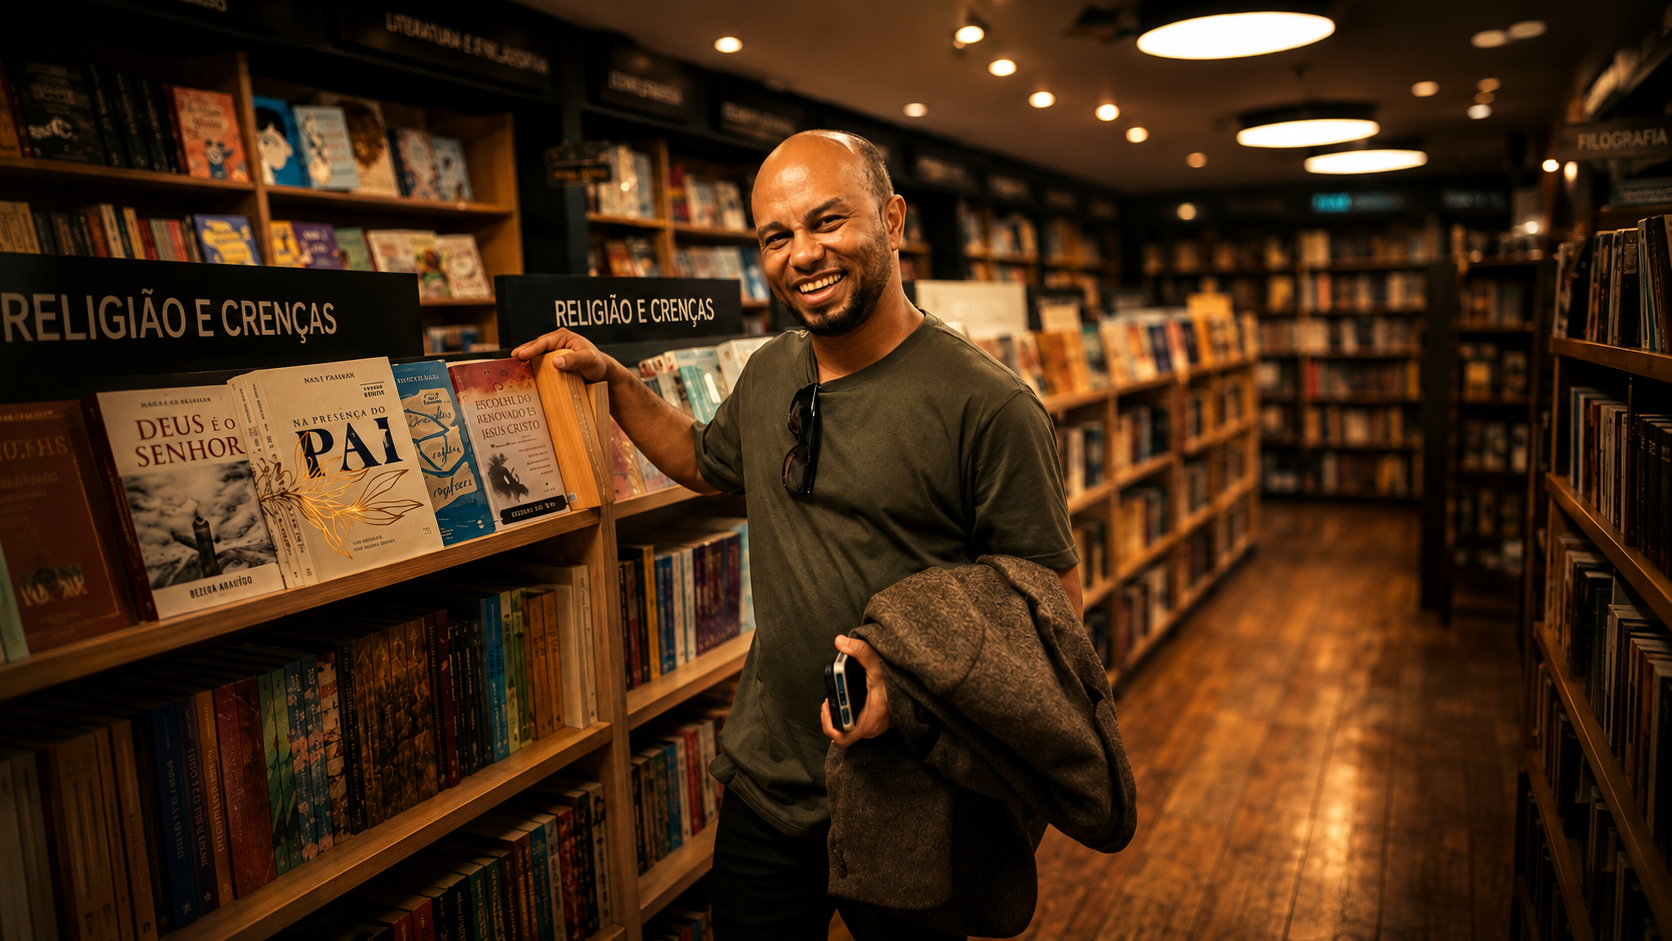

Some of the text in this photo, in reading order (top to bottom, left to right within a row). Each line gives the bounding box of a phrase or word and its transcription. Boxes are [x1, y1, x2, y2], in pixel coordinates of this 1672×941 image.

[1577, 128, 1668, 151] FILOGRAFIA
[0, 288, 338, 344] RELIGIÃO E CRENÇAS
[555, 293, 715, 328] RELIGIÃO E CRENÇAS
[134, 414, 205, 441] DEUS
[224, 418, 236, 430] O
[292, 406, 386, 428] NA PRESENÇA DO
[481, 420, 541, 440] JESUS CRISTO
[135, 436, 246, 467] SENHOR
[295, 416, 403, 479] PAI
